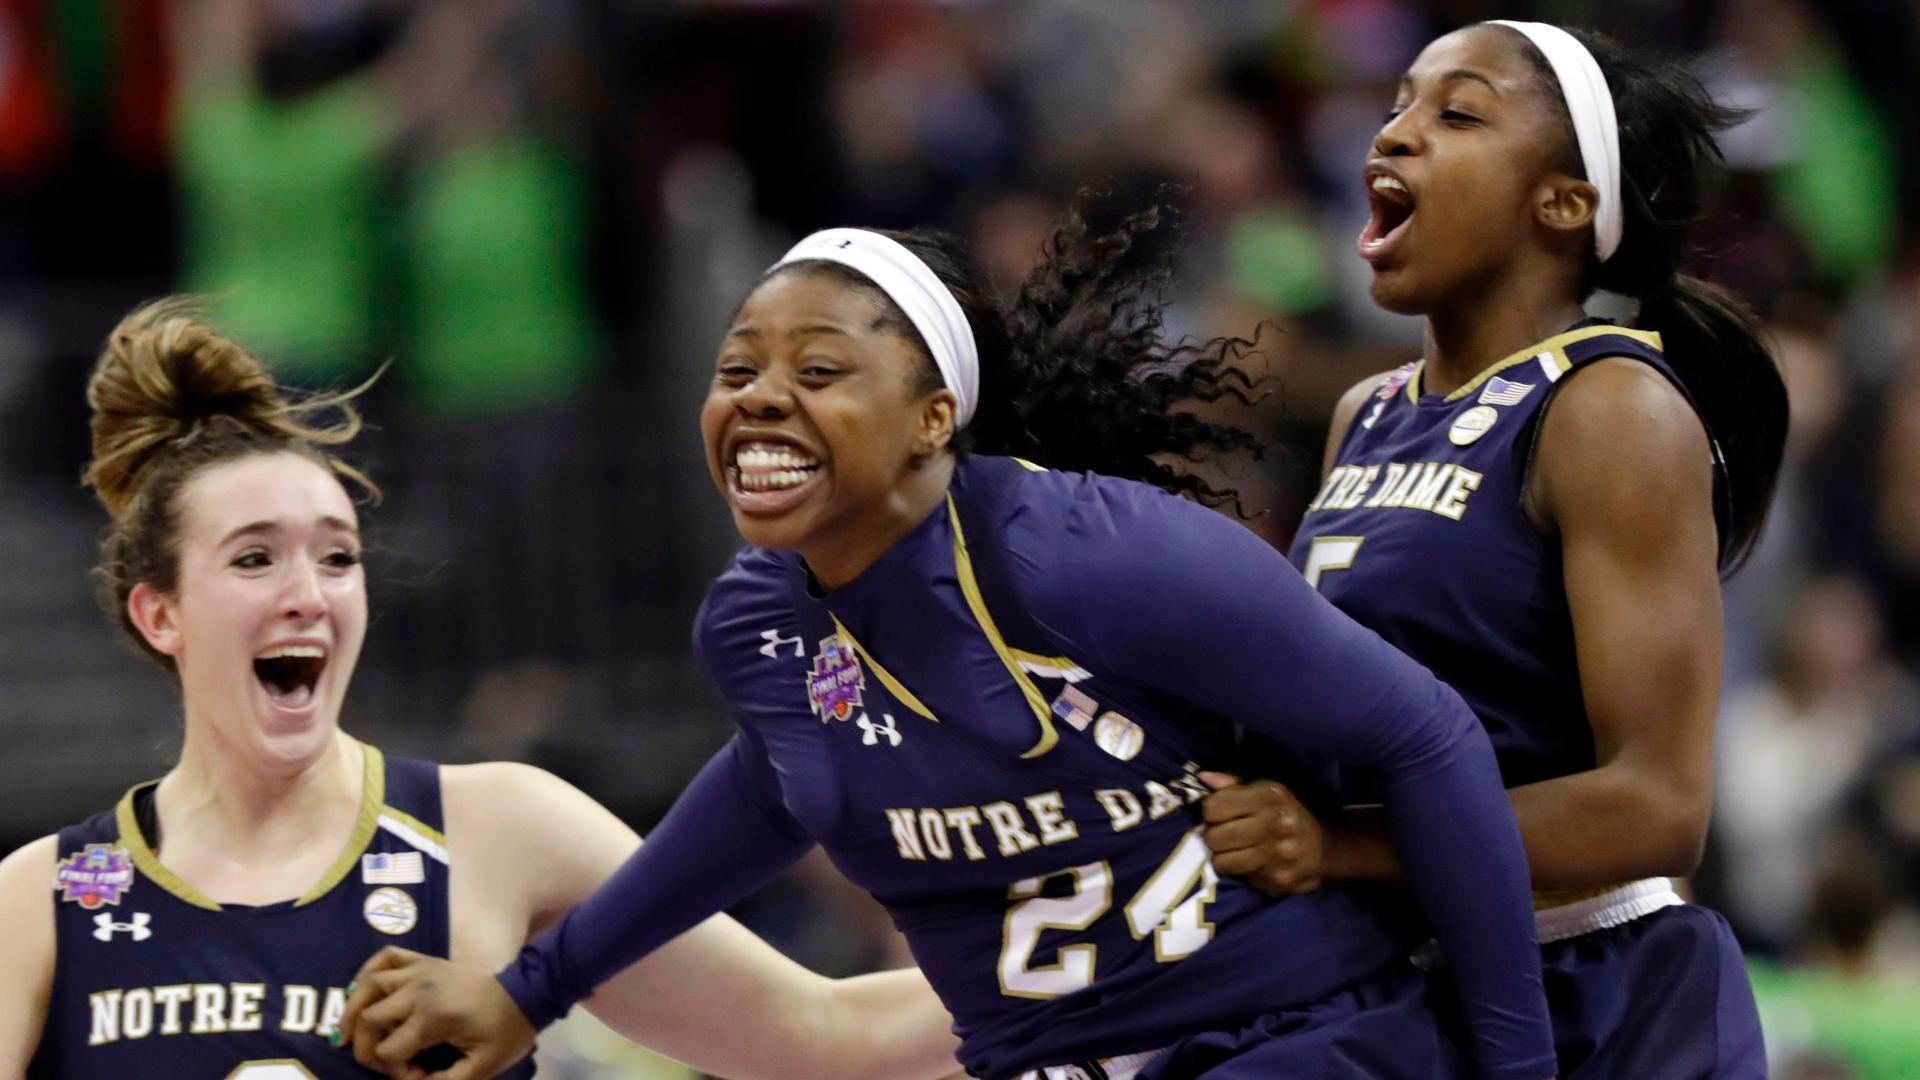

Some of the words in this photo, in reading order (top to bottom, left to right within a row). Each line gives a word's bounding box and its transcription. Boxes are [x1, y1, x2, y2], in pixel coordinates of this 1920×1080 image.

[1306, 464, 1381, 511] TRE
[1363, 462, 1484, 521] DAME
[886, 790, 1079, 862] NOTRE
[1094, 760, 1211, 832] DAM
[999, 828, 1220, 999] 24
[88, 982, 266, 1046] NOTRE
[280, 984, 348, 1038] DA
